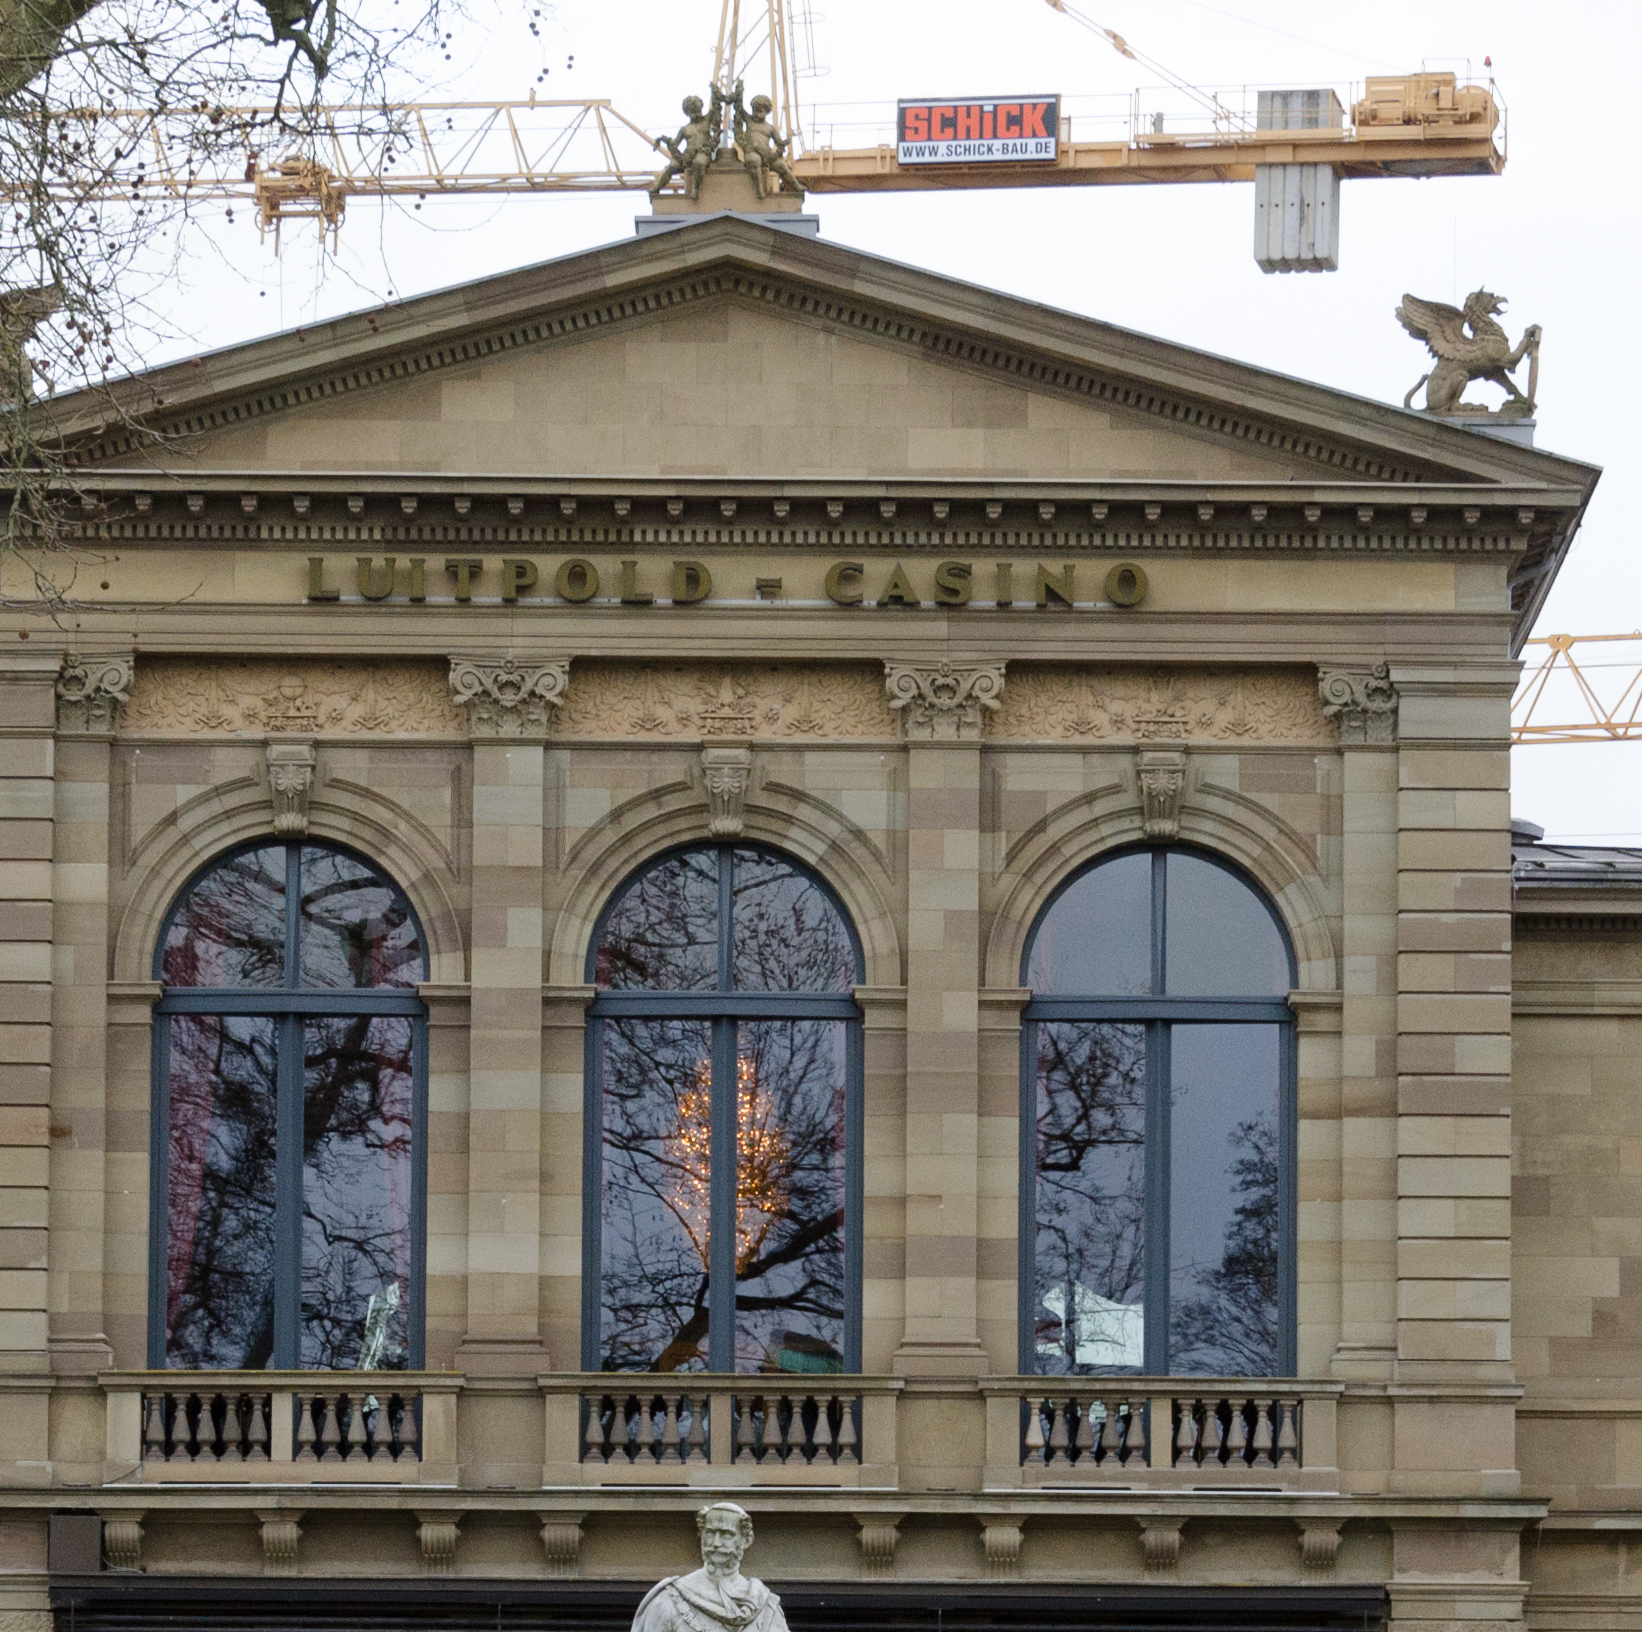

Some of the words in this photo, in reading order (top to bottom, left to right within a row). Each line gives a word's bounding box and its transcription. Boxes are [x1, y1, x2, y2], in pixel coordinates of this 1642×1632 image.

[902, 141, 1052, 158] WWW.SCHICK-BAU.DE
[307, 557, 713, 605] LUITPOLD
[824, 561, 1150, 608] CASINO
